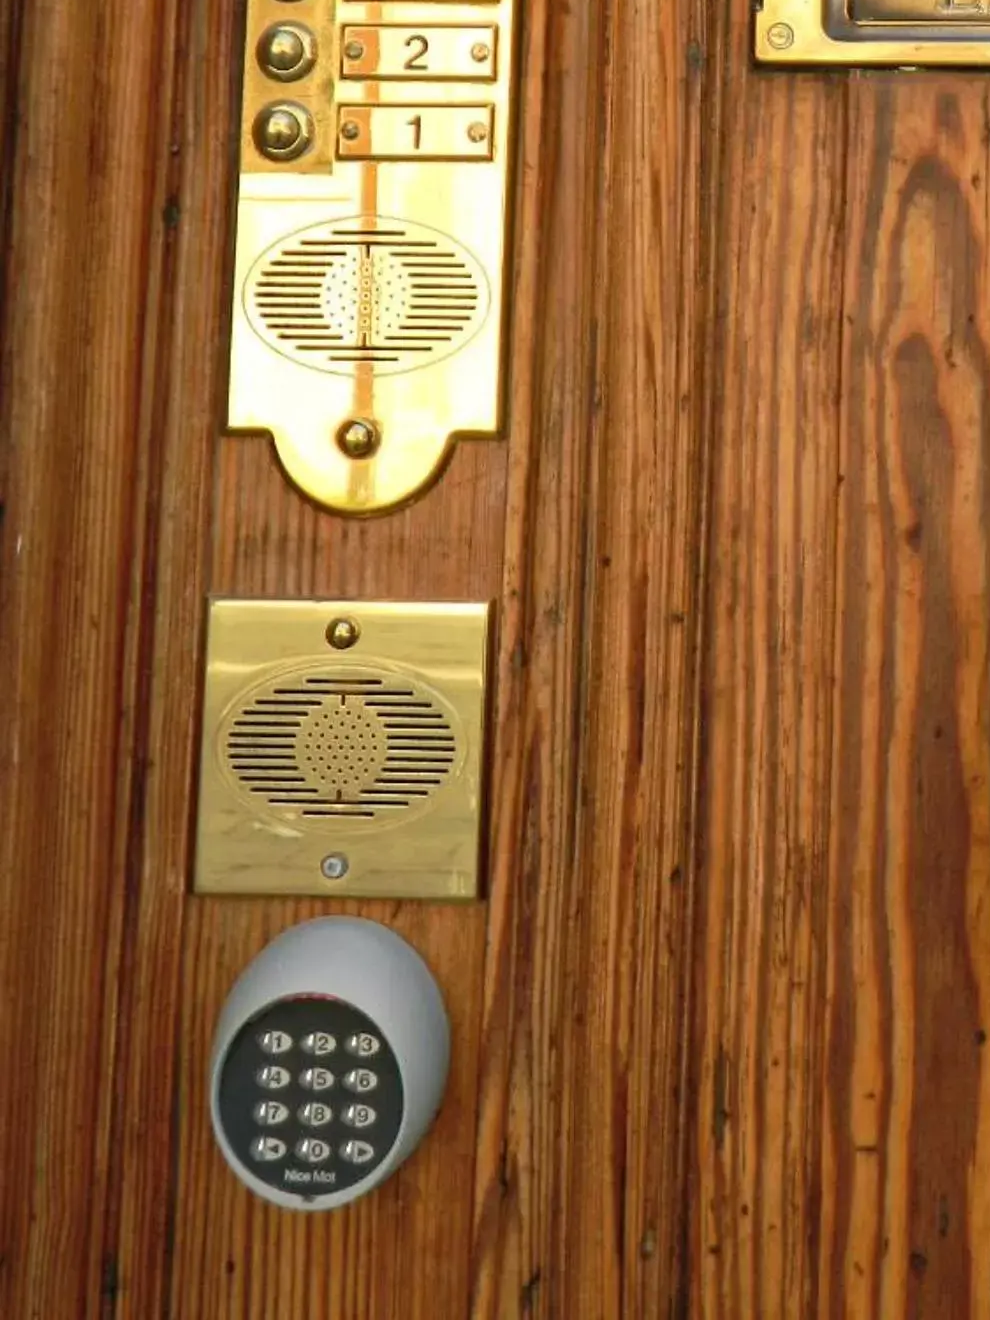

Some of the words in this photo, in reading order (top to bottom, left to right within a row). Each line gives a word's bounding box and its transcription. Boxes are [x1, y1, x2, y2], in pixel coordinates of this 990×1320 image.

[403, 34, 430, 71] 2
[406, 114, 422, 150] 1
[274, 1036, 282, 1049] 1
[317, 1036, 329, 1052] 2
[362, 1038, 373, 1052] 3
[269, 1071, 281, 1085] 4
[316, 1072, 327, 1087] 5
[359, 1072, 371, 1087] 6
[269, 1106, 281, 1120] 7
[313, 1107, 325, 1121] 8
[357, 1107, 369, 1122] 9
[312, 1143, 323, 1158] 0
